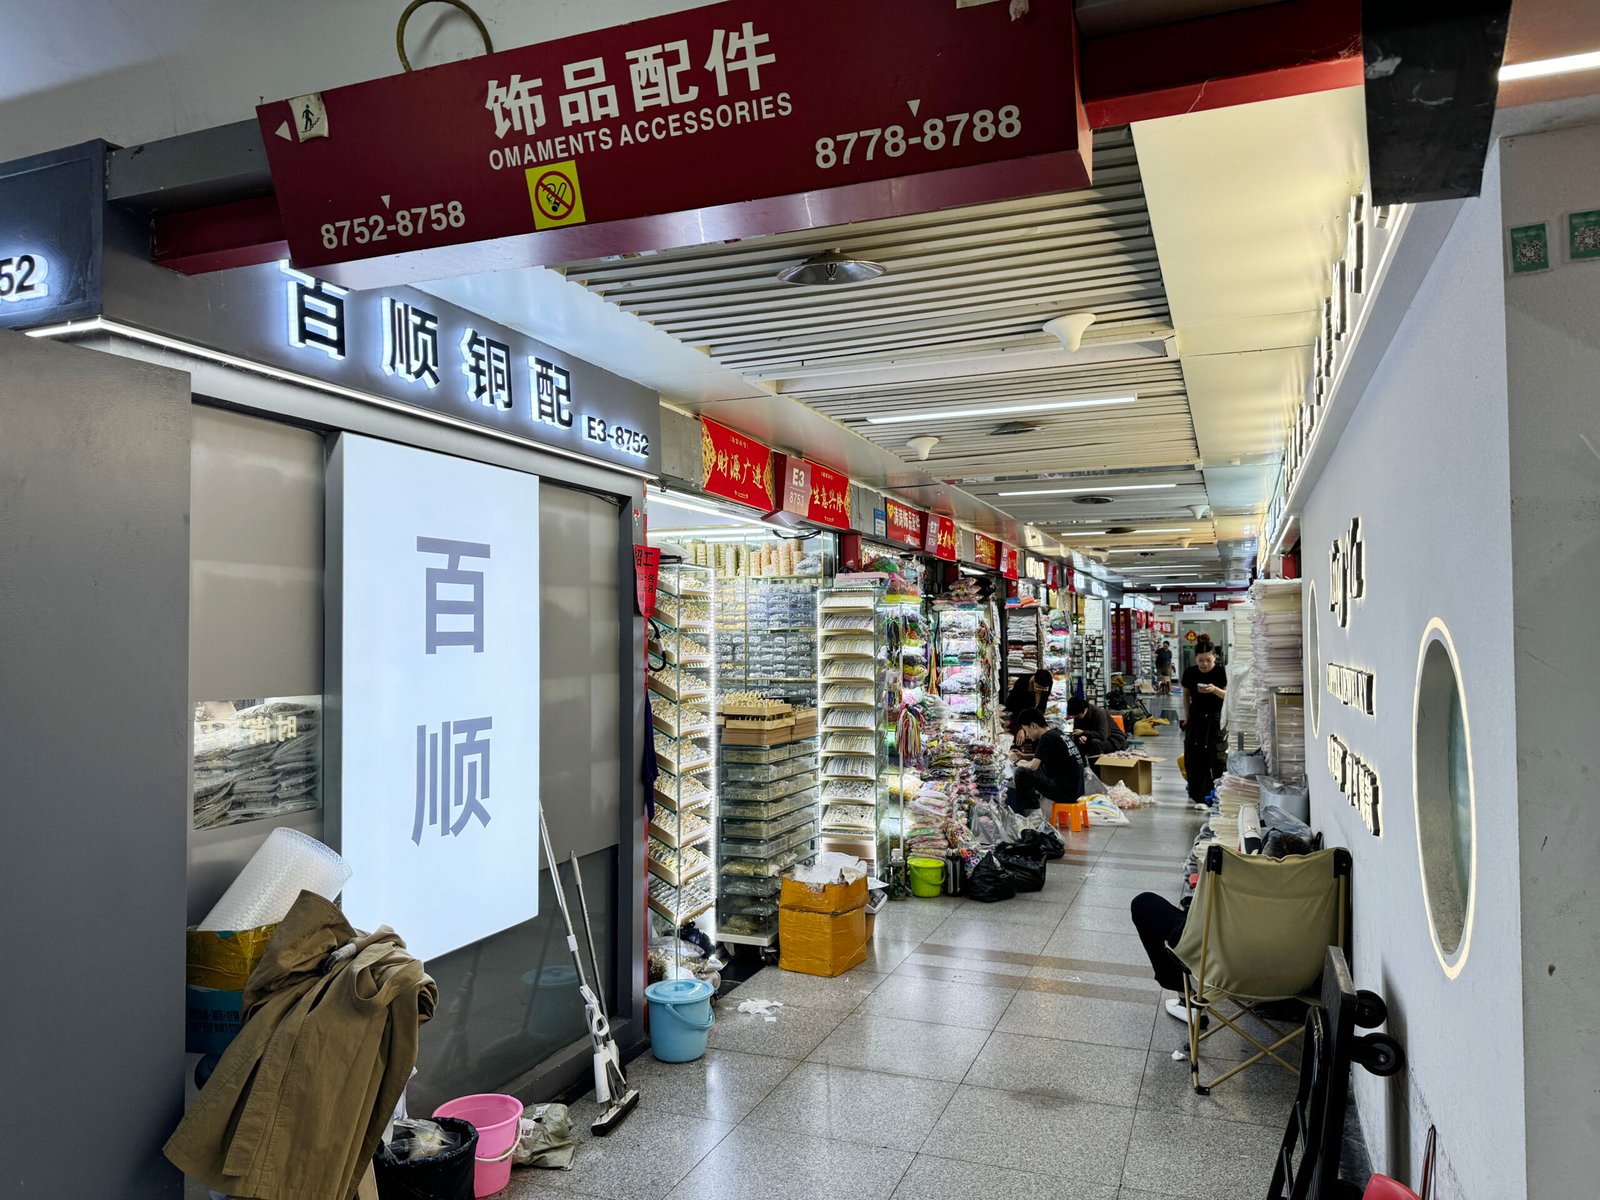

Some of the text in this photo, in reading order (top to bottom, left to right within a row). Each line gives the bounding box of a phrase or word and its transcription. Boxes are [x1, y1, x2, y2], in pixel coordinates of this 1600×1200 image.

[485, 21, 777, 139] 饰品配件
[488, 92, 793, 171] OMAMENTS ACCESSORIES
[815, 105, 1022, 169] 8778-8788
[320, 200, 466, 250] 8752-8758
[282, 262, 573, 428] 百顺铜配
[584, 415, 649, 457] E3-8752
[716, 448, 763, 489] 财源广进
[792, 468, 805, 487] E3
[789, 491, 805, 506] 8753
[813, 483, 844, 513] 生意兴隆
[411, 535, 493, 847] 百顺
